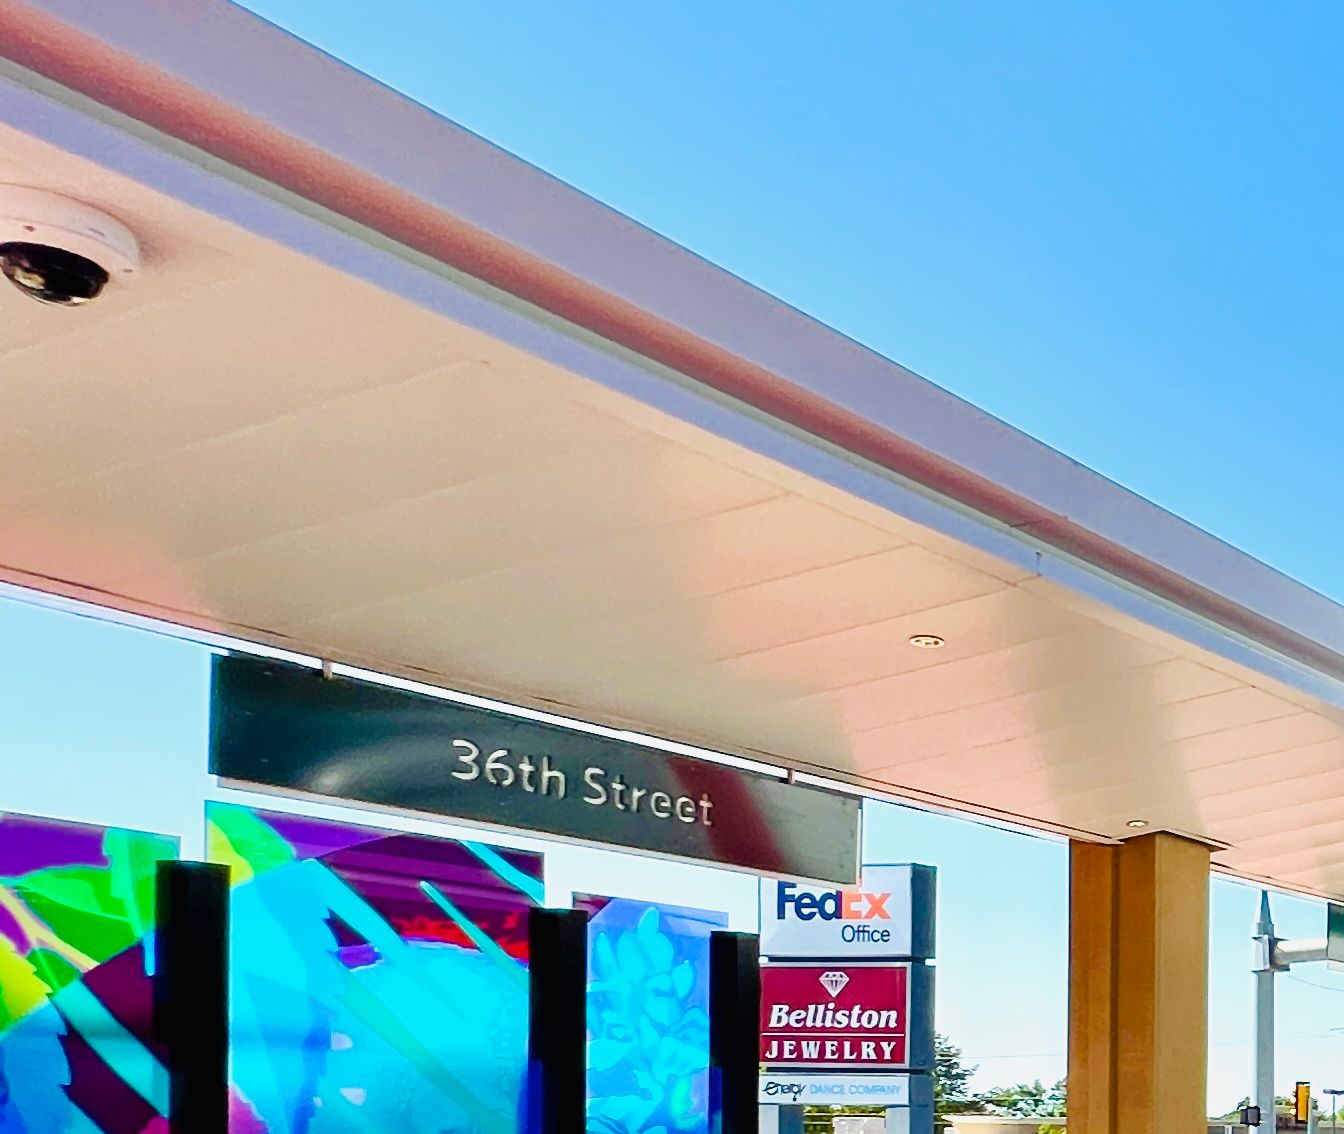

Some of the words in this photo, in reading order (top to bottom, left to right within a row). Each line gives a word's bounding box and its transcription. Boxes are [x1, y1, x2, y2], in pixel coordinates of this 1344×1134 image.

[451, 738, 567, 800] 36th
[583, 766, 714, 826] Street
[777, 880, 892, 921] FedEx
[841, 924, 891, 943] Office
[768, 1002, 898, 1029] Belliston
[765, 1040, 897, 1060] JEWELRY
[810, 1084, 845, 1095] DANCE
[848, 1084, 902, 1096] COMPANY
